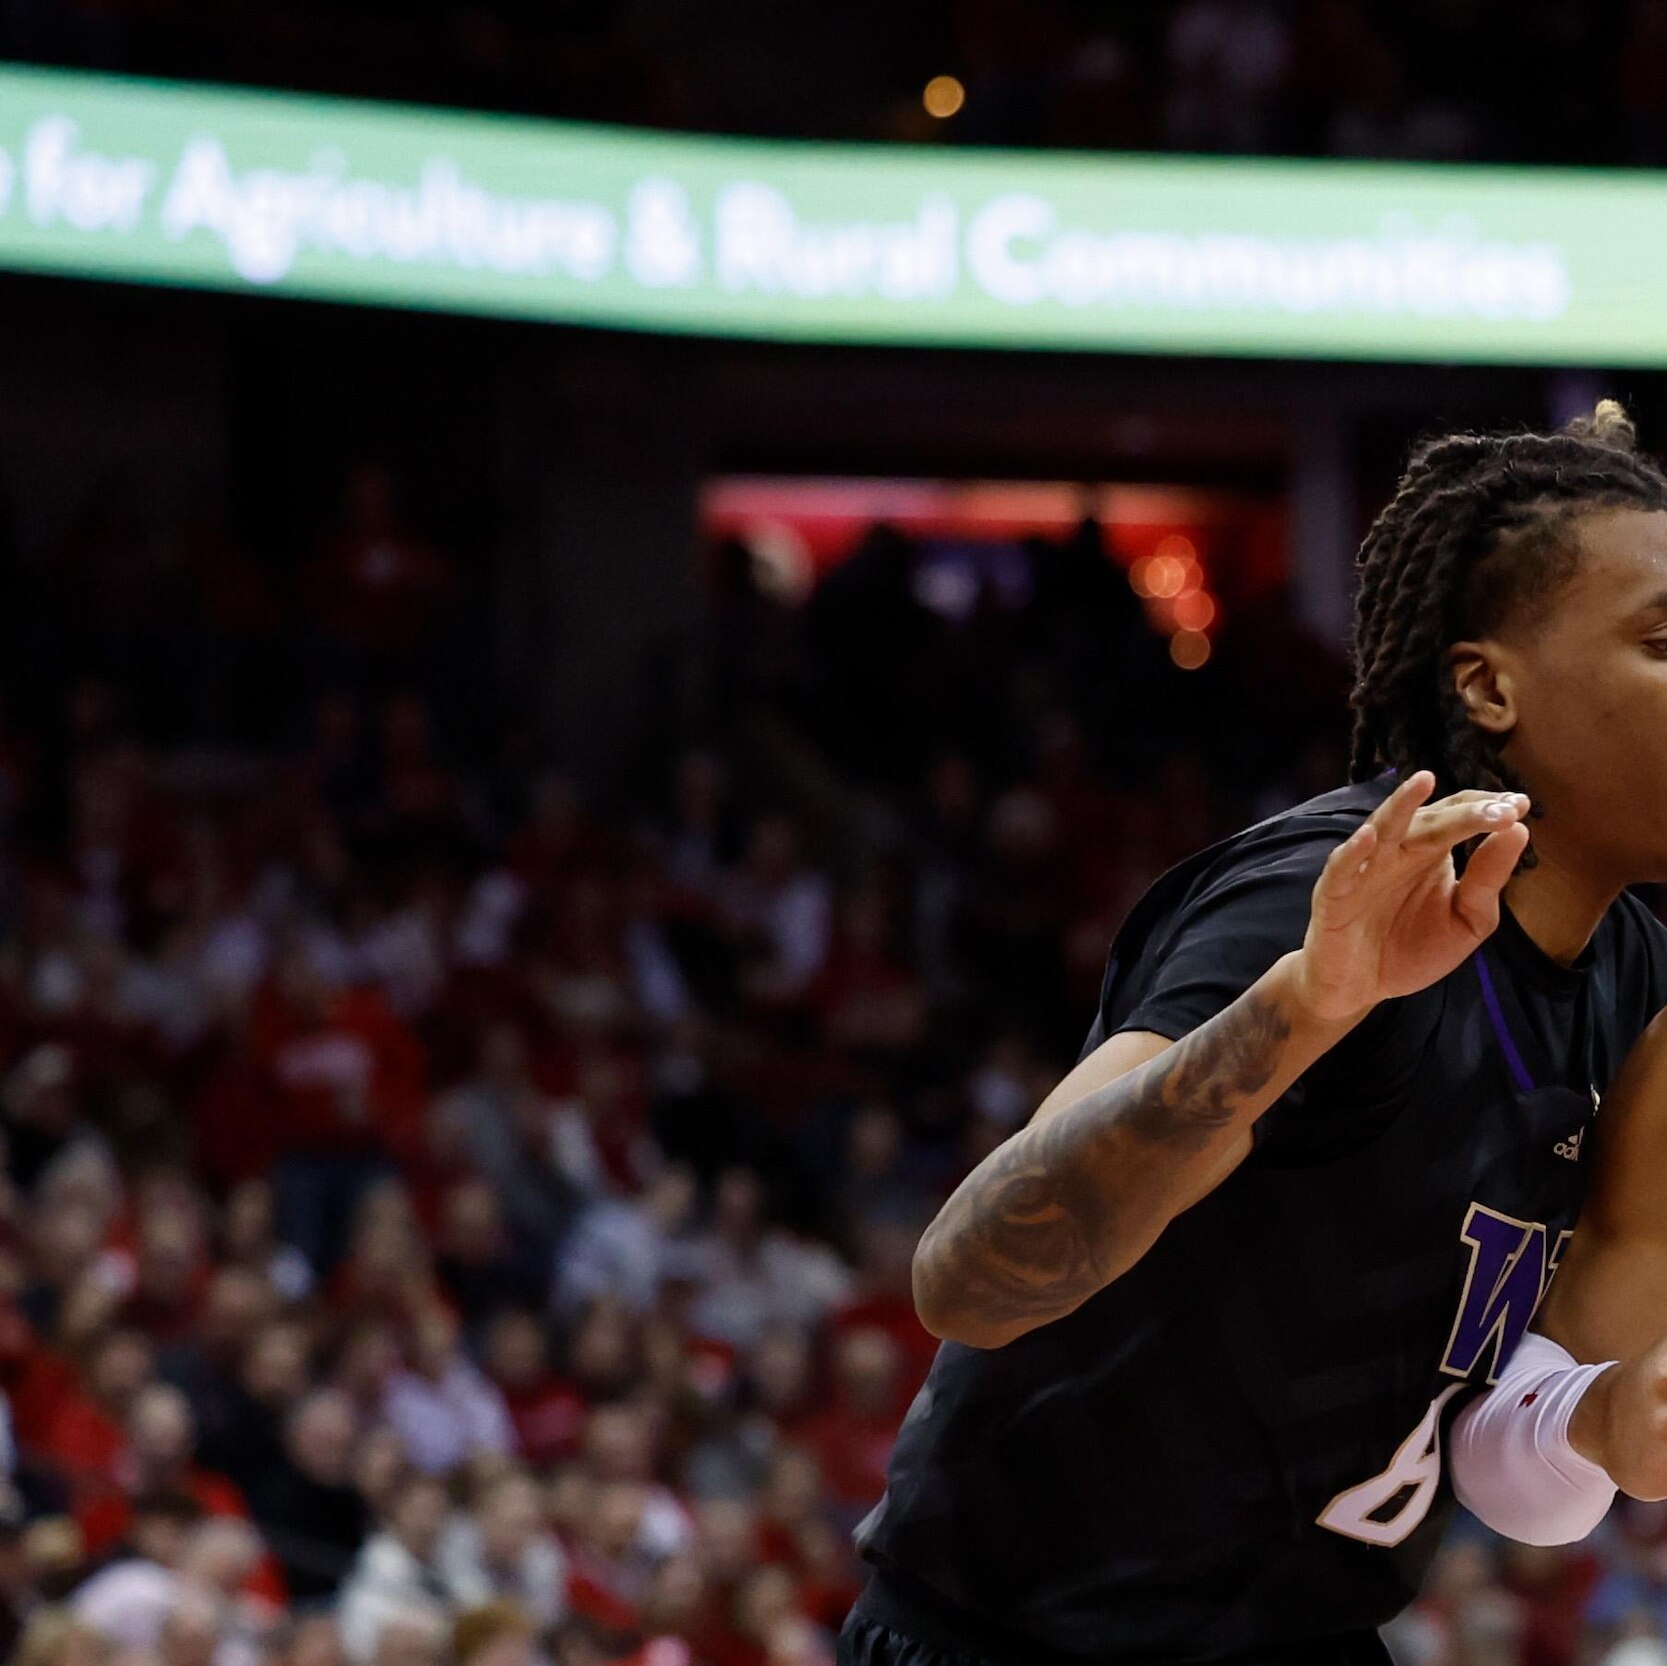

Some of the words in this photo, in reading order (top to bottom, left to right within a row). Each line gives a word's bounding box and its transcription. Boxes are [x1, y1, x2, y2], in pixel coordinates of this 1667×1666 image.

[163, 132, 616, 284] Agriculture
[715, 180, 960, 303] Rural
[967, 195, 1570, 320] Communities
